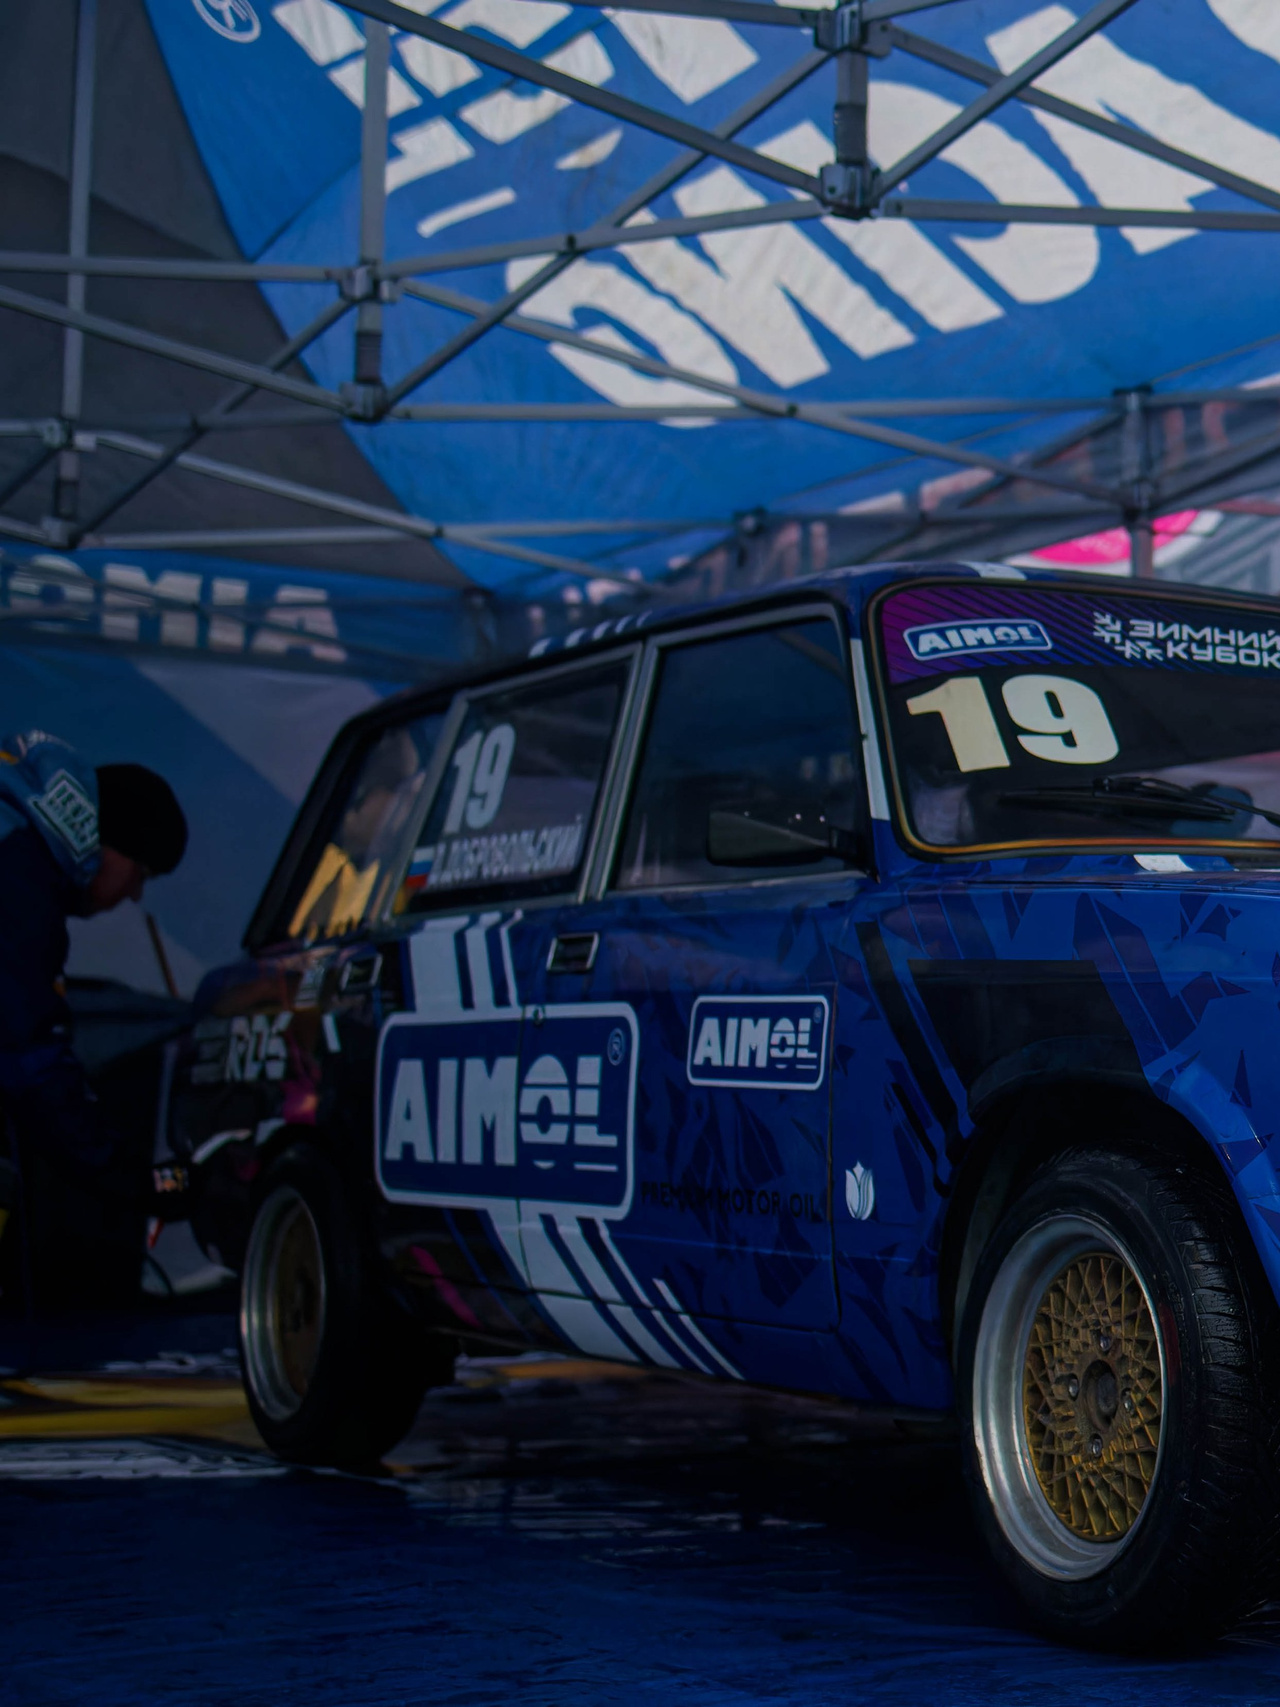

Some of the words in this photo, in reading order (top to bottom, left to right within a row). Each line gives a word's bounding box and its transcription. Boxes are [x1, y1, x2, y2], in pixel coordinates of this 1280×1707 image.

[917, 624, 1039, 654] AIMOL
[906, 672, 1120, 774] 19
[442, 721, 516, 836] 19
[691, 1016, 819, 1070] AIMOL
[383, 1053, 620, 1173] AIMOL
[715, 1185, 780, 1216] MOTOR
